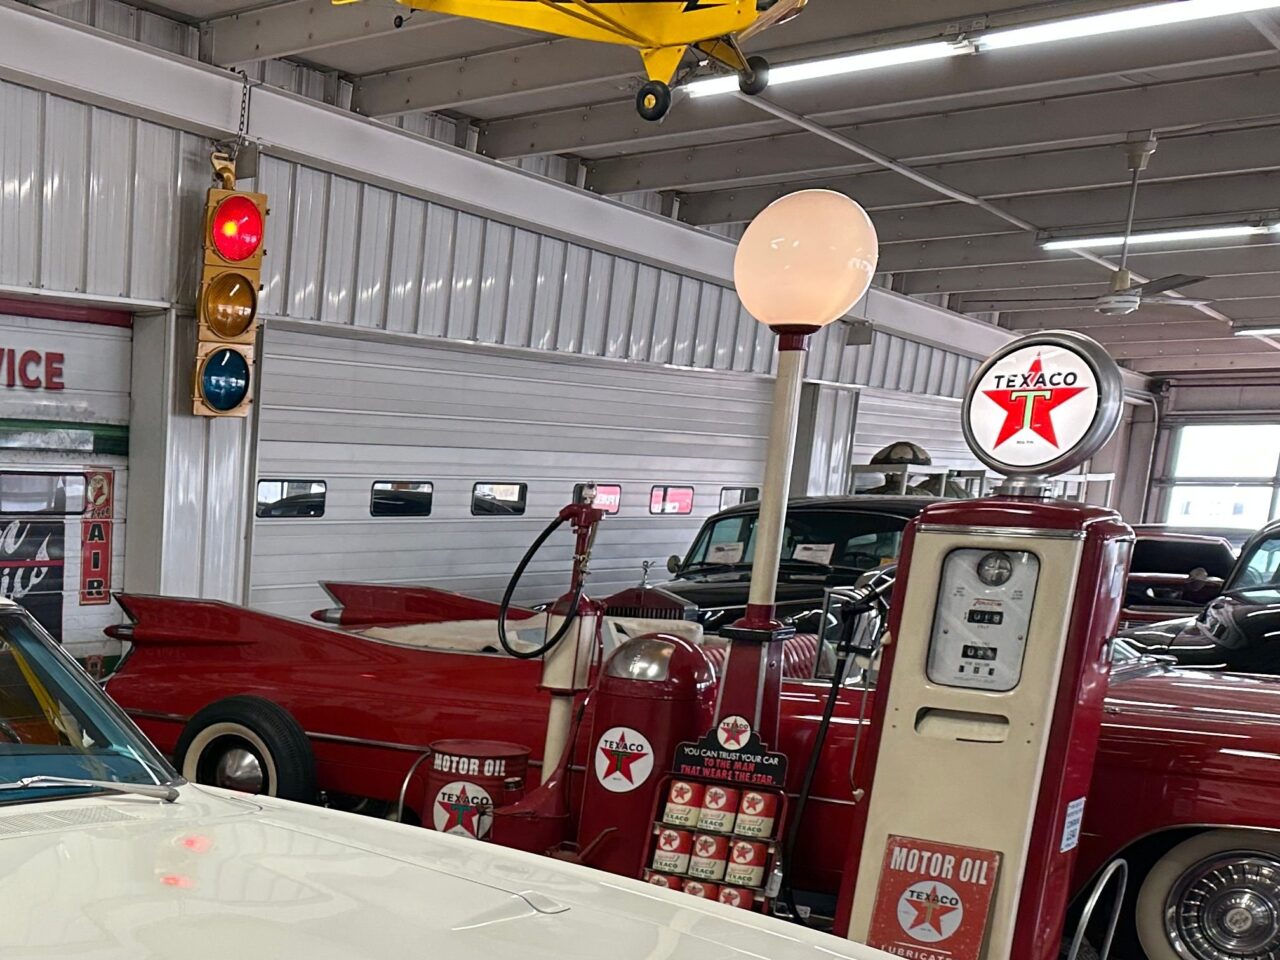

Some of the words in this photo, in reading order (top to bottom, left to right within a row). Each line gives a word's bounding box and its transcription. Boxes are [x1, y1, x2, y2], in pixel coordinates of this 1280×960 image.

[994, 372, 1078, 388] TEXACO
[87, 522, 106, 598] AIR
[722, 721, 749, 730] TEXACO
[603, 740, 644, 752] TEXACO
[433, 753, 480, 776] MOTOR
[484, 759, 506, 776] OIL
[684, 747, 699, 756] YOU
[701, 749, 718, 758] CAN
[719, 751, 740, 761] TRUST
[741, 753, 762, 763] YOUR
[763, 756, 779, 765] CAR
[680, 765, 701, 775] THAT
[702, 767, 733, 781] WEARS
[734, 770, 750, 782] THE
[704, 758, 714, 766] TO
[716, 759, 731, 769] THE
[733, 761, 755, 772] MAN
[441, 792, 490, 806] TEXACO
[890, 846, 956, 880] MOTOR
[959, 857, 988, 886] OIL
[909, 889, 959, 906] TEXACO
